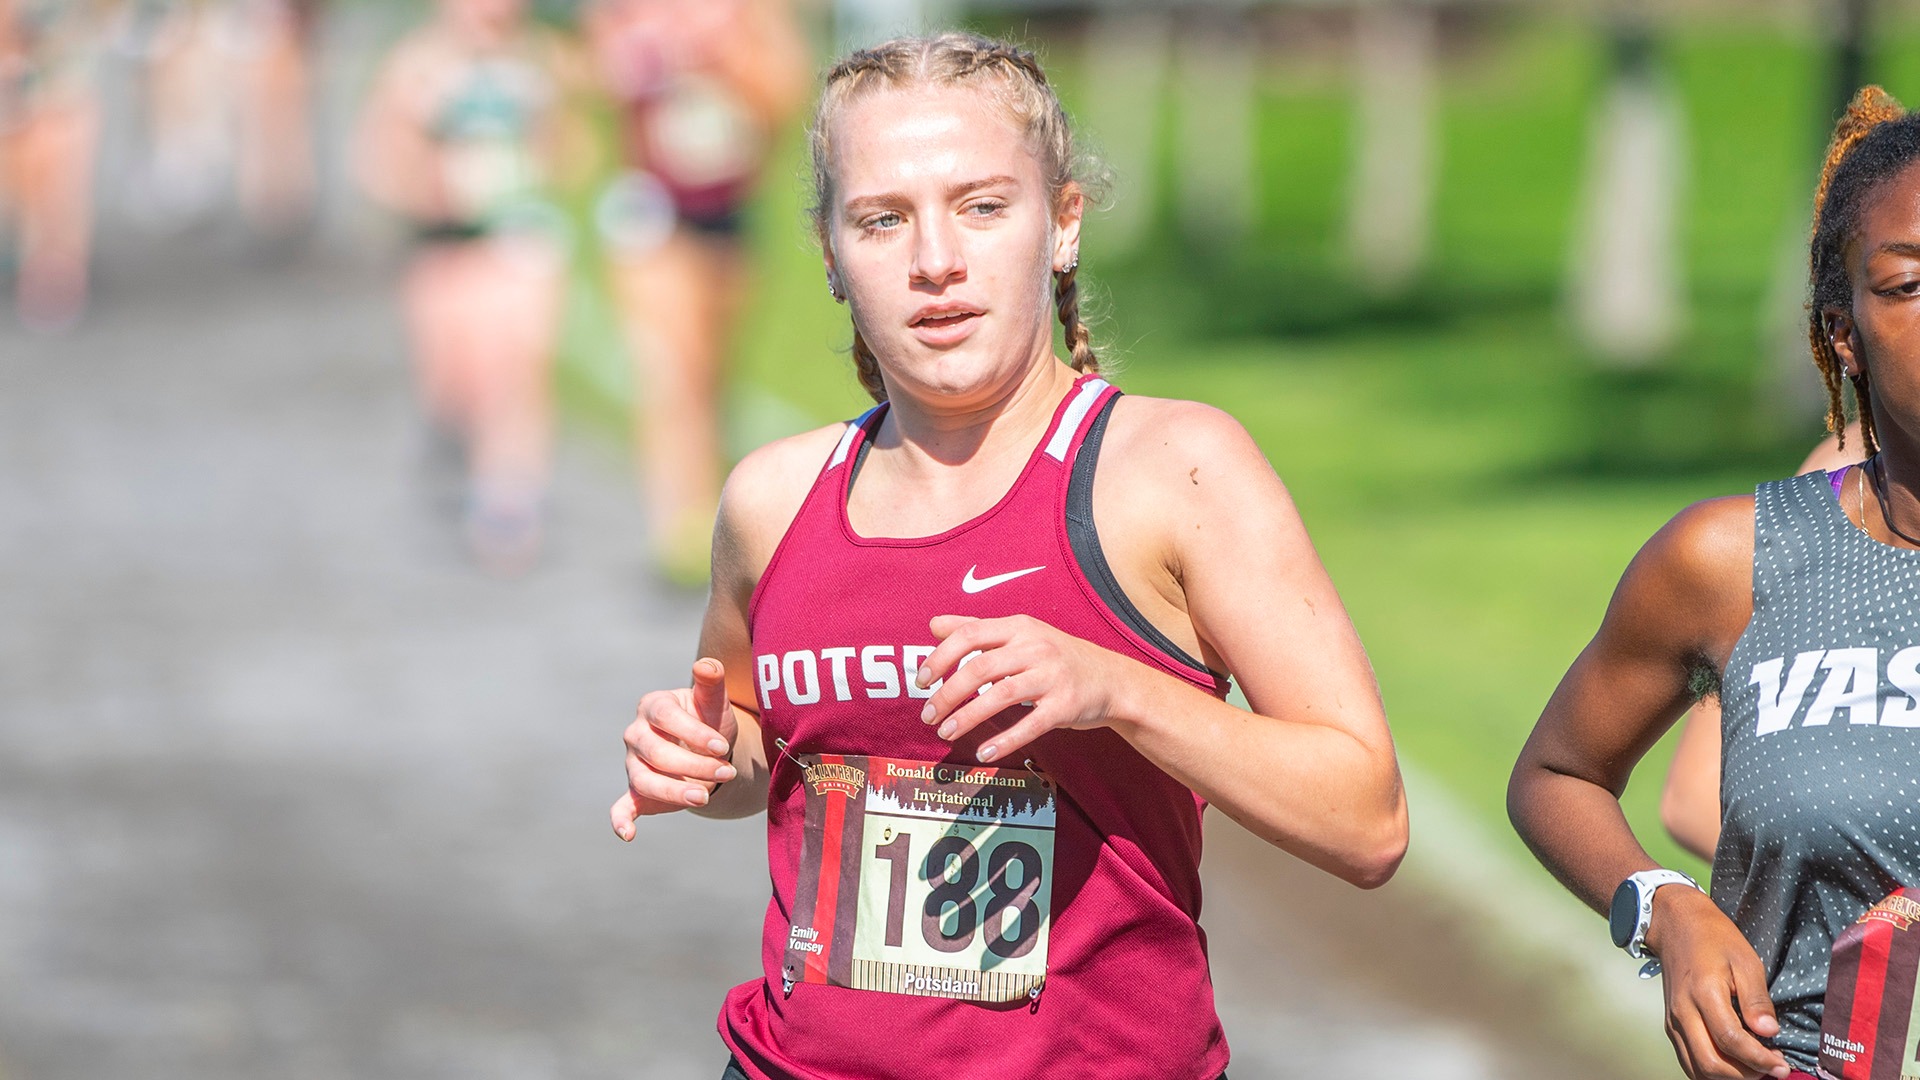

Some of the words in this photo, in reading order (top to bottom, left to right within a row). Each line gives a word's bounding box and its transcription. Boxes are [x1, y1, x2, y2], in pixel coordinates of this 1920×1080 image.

[757, 645, 1033, 710] POTSD
[1748, 646, 1920, 738] VAS
[822, 782, 850, 790] SAINTS
[886, 763, 935, 780] Ronald
[938, 768, 951, 781] C.
[955, 770, 1026, 788] Hoffmann
[913, 787, 994, 807] Invitational
[875, 833, 1042, 958] 188
[790, 925, 819, 943] Emily
[788, 937, 824, 955] Yousey
[904, 973, 979, 995] Potsdam
[1822, 1045, 1857, 1063] Jones
[1823, 1033, 1865, 1054] Mariah
